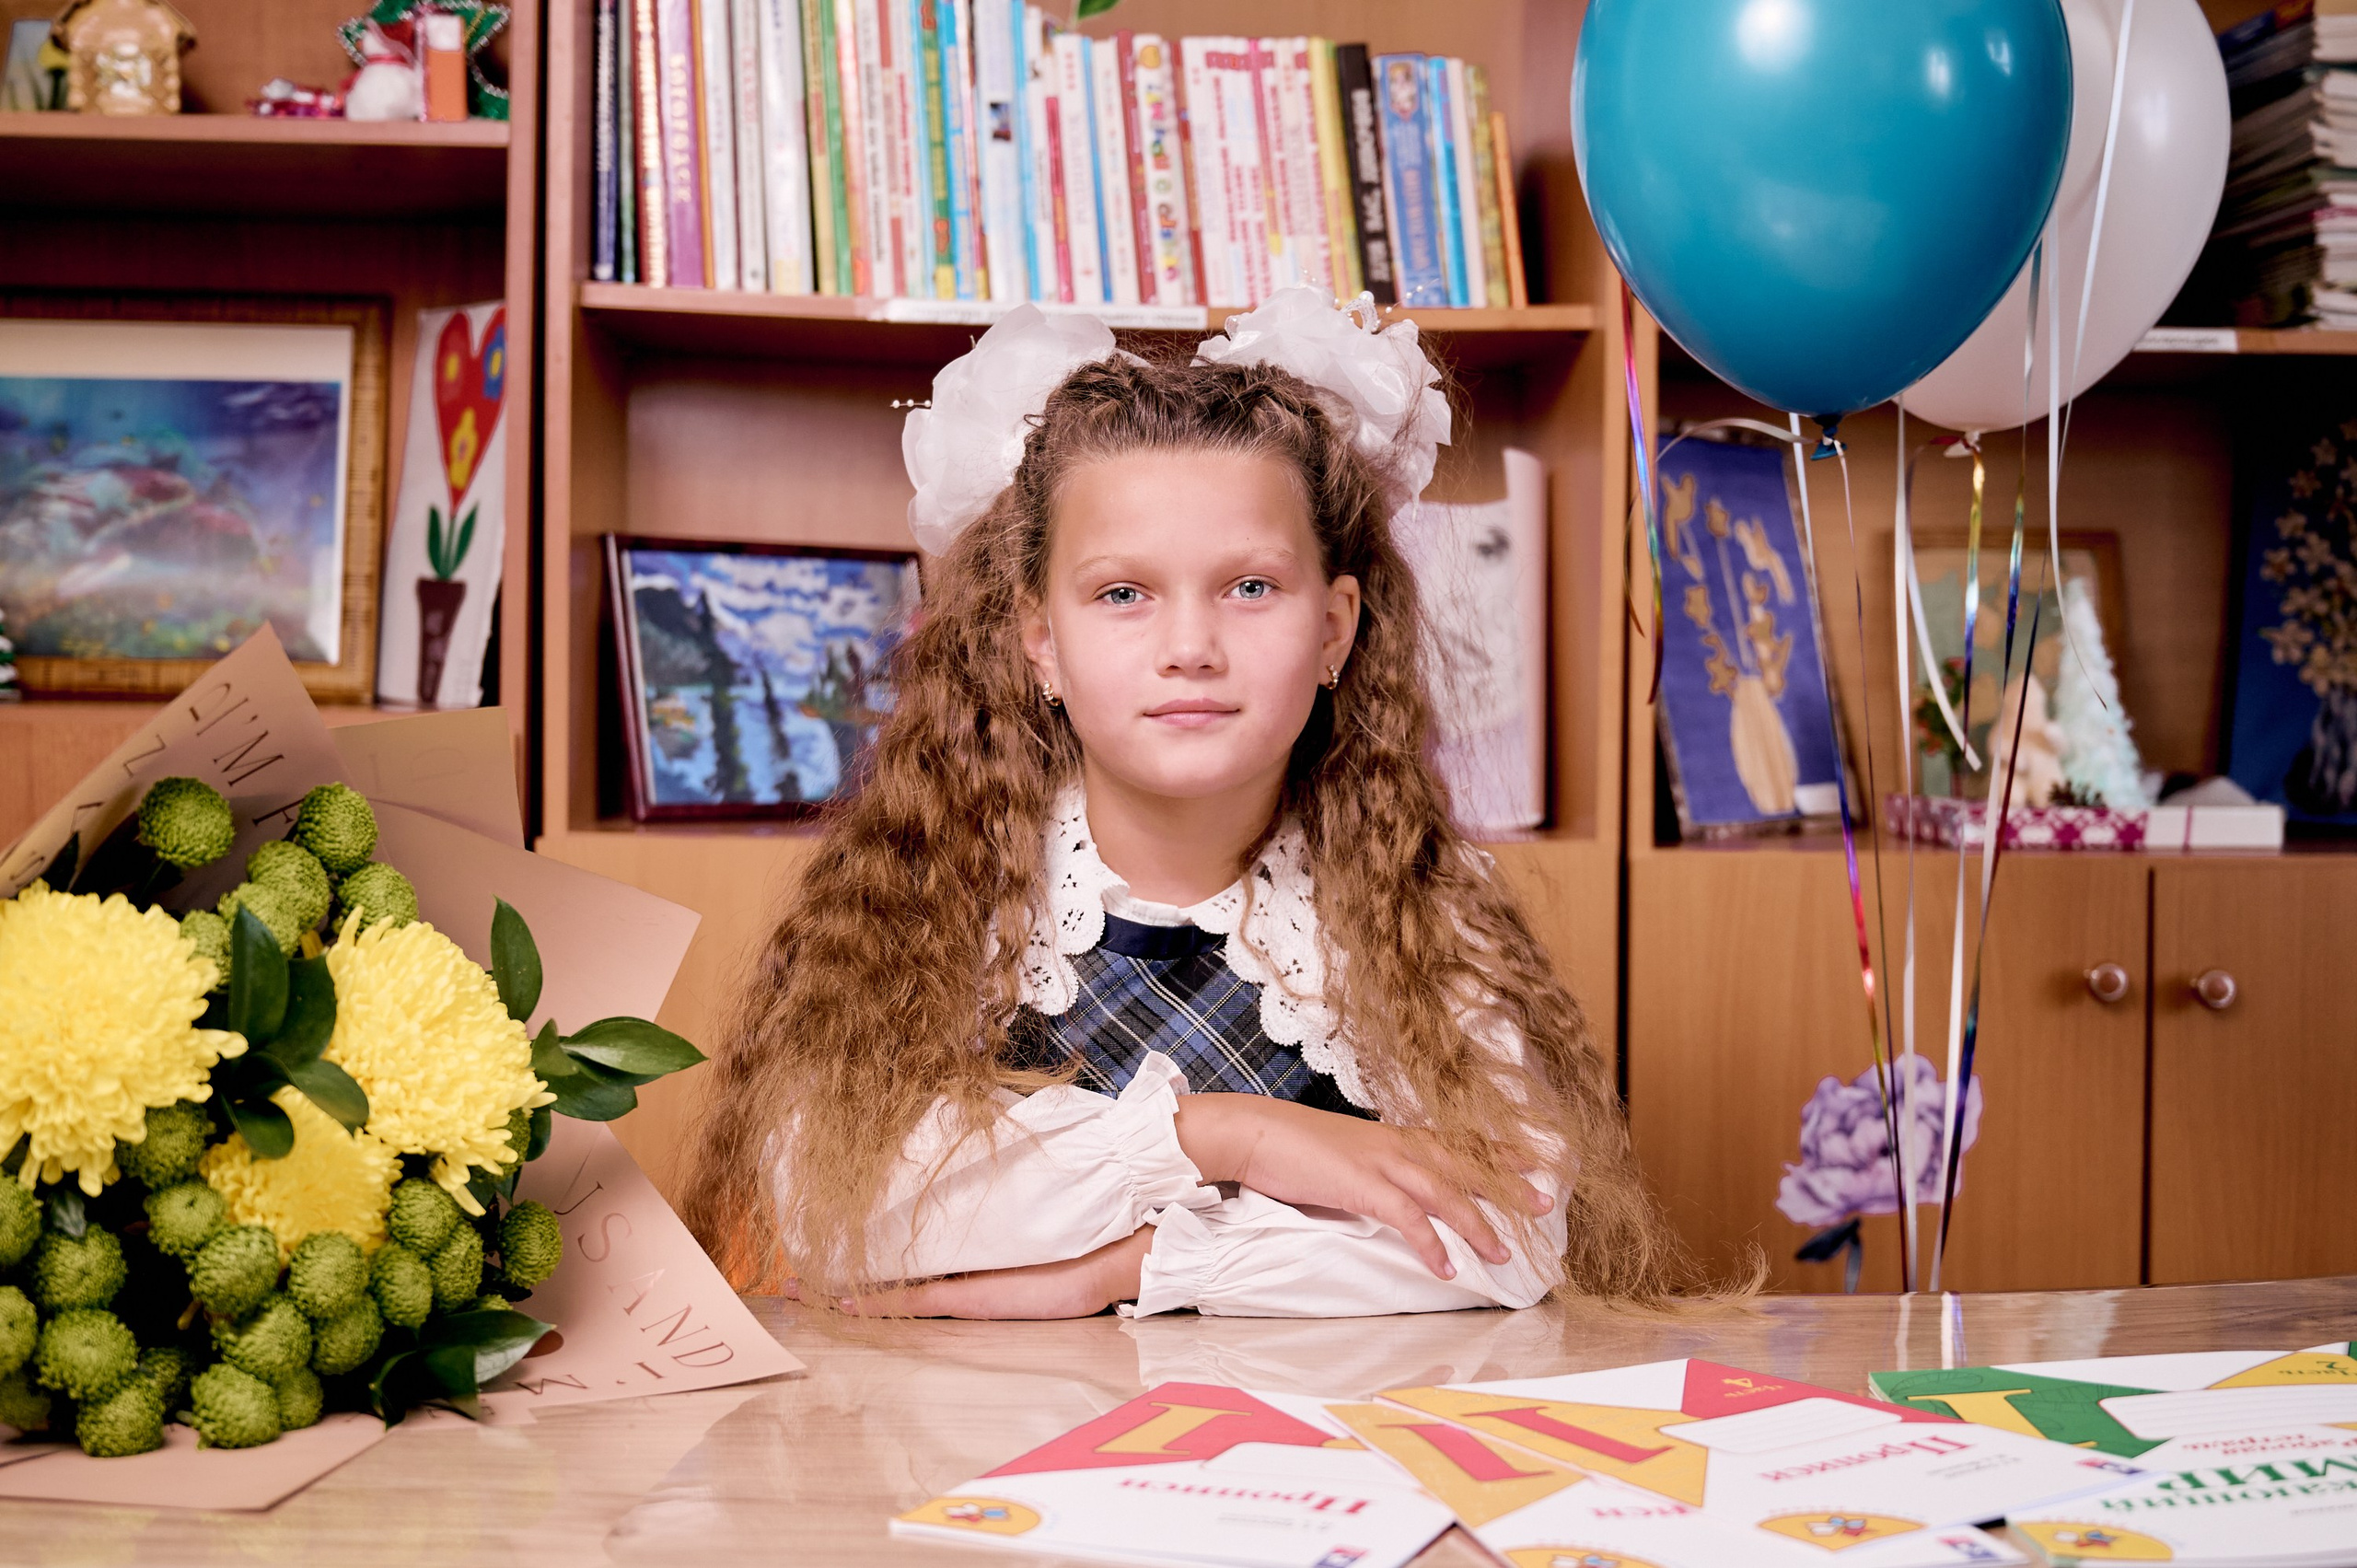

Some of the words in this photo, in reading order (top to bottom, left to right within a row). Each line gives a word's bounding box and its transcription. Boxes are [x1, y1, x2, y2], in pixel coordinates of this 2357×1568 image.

[195, 696, 286, 788] I'M
[608, 1268, 736, 1370] AND
[1722, 1376, 1754, 1389] 4
[1754, 1434, 1975, 1484] Прописи
[1116, 1478, 1376, 1516] Прописи
